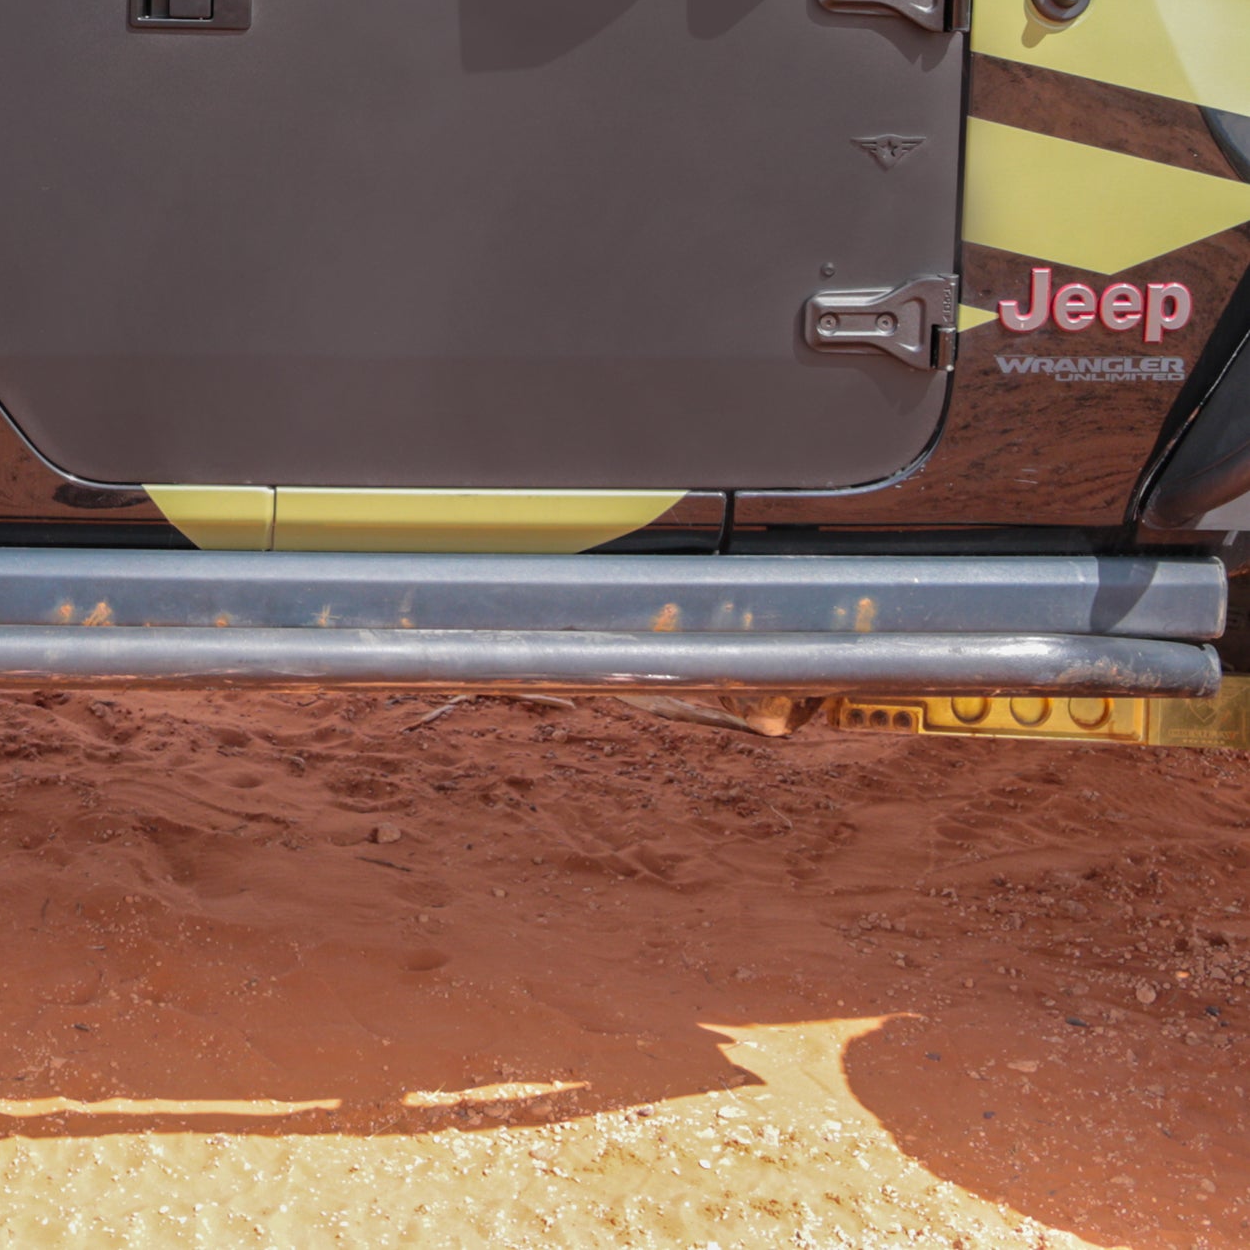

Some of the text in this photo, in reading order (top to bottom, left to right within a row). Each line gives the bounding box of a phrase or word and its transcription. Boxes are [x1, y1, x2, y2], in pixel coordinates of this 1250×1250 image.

[998, 267, 1193, 344] Jeep
[994, 354, 1186, 374] WRANGLER
[1054, 373, 1186, 382] UNLIMITED
